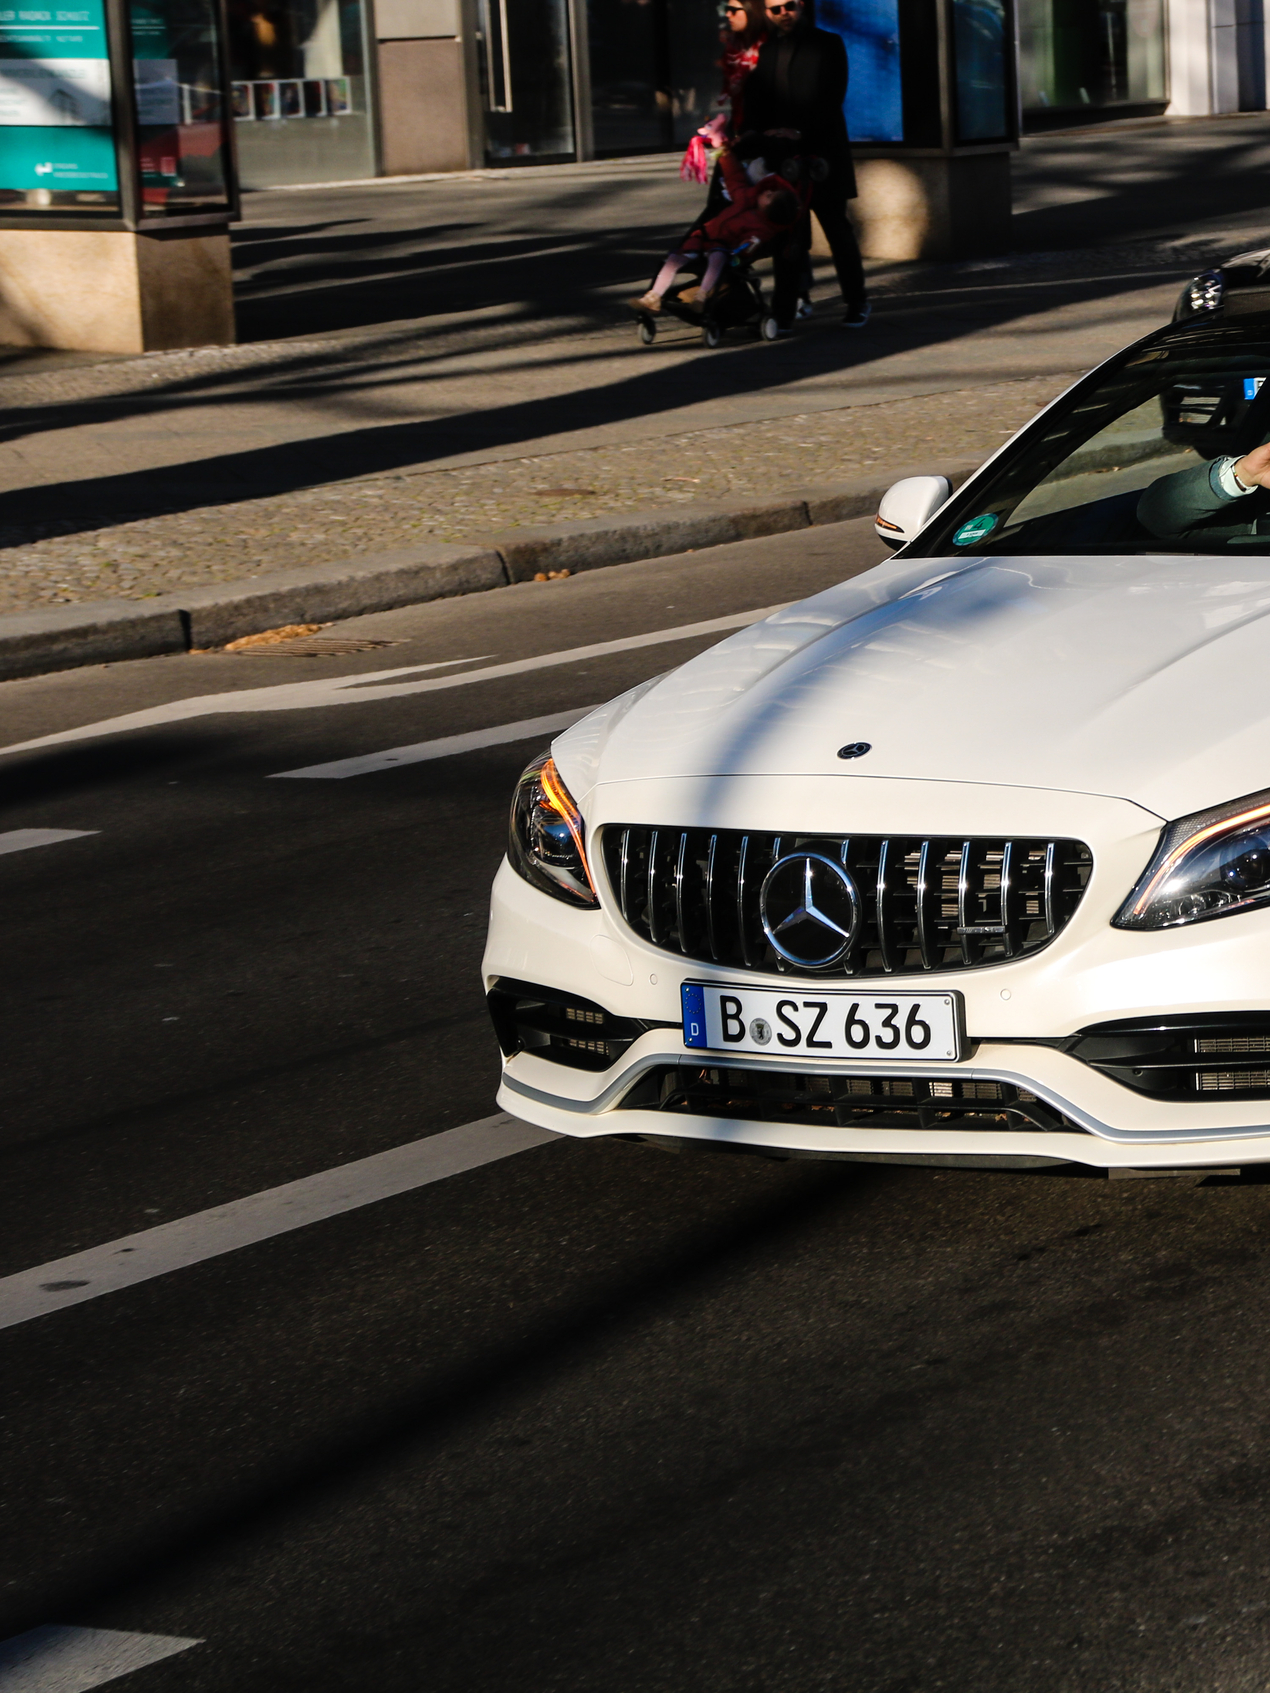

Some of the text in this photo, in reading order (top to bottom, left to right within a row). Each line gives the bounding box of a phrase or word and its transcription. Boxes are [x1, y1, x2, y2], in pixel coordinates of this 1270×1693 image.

[973, 518, 986, 530] 4
[690, 994, 932, 1050] D B SZ 636
